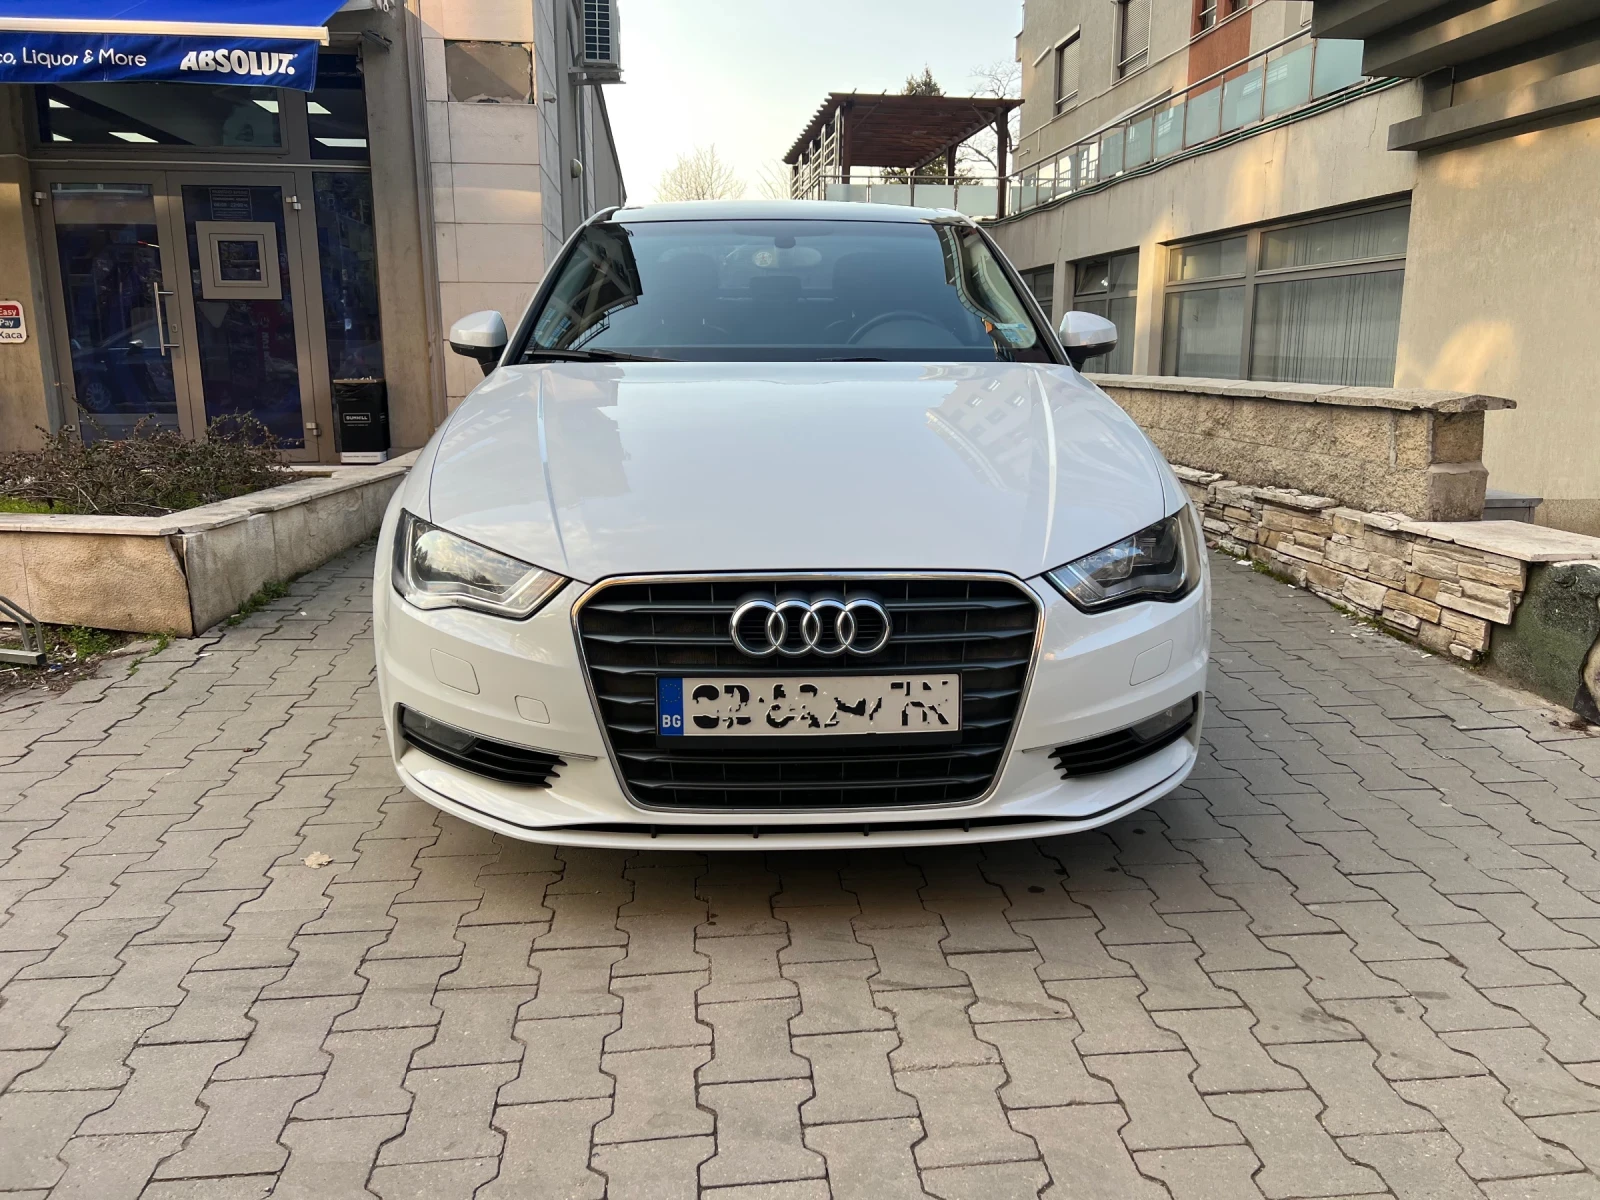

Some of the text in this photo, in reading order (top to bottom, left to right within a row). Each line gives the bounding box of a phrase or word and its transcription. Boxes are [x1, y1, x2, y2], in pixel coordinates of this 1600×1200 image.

[22, 47, 79, 68] Liquor
[83, 49, 94, 64] &
[98, 48, 147, 67] More
[662, 714, 681, 728] BG
